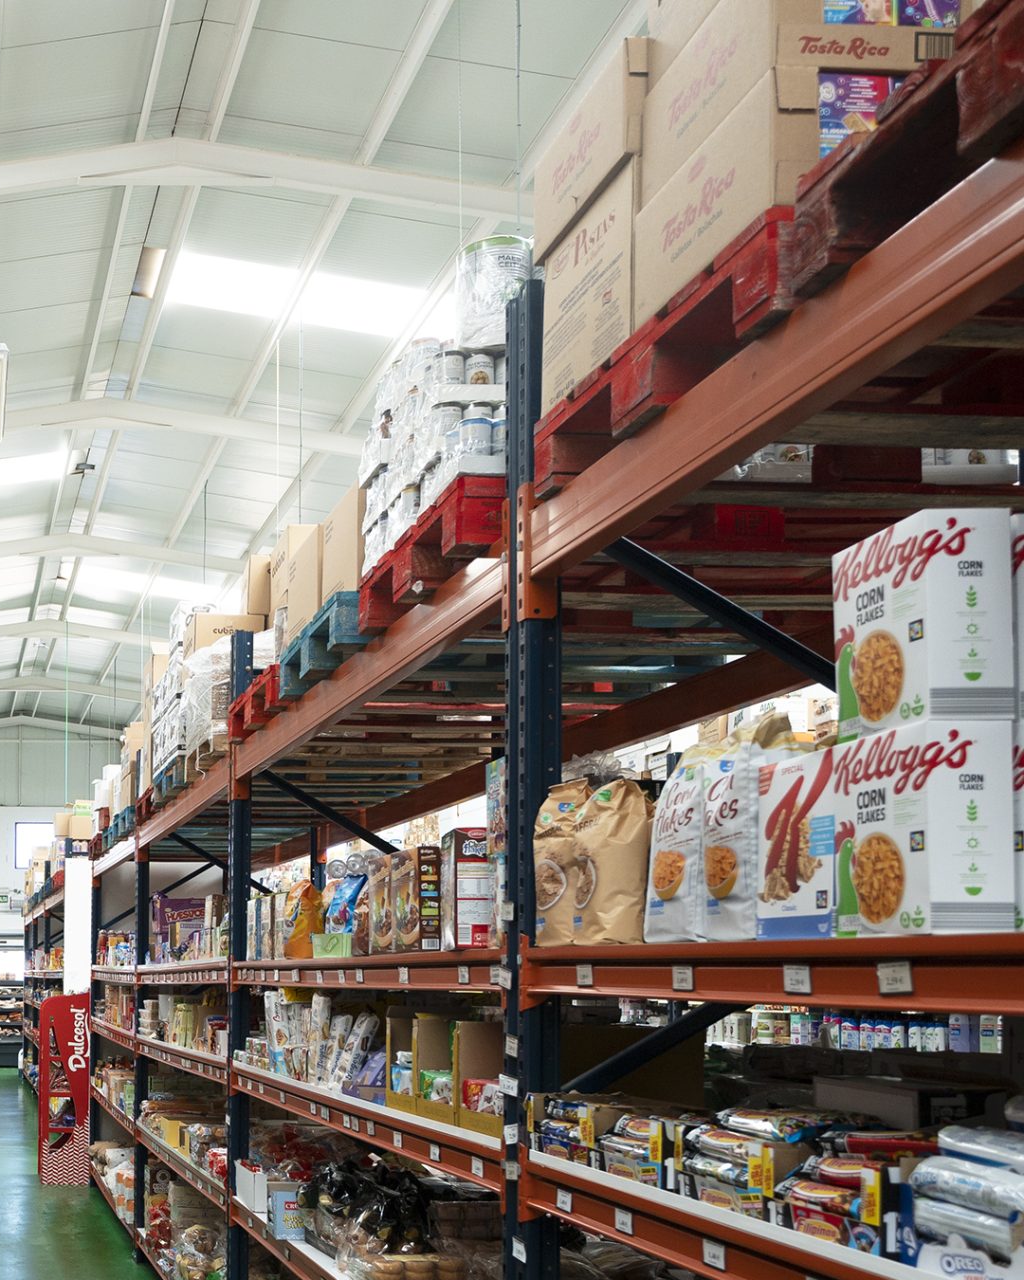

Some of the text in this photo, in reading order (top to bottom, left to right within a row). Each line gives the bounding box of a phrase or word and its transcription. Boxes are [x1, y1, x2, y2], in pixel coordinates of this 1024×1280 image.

[799, 36, 890, 59] Tosta Rica
[662, 167, 736, 252] Tosta Rica
[833, 517, 971, 602] Kellogg's
[957, 560, 983, 570] CORN
[958, 569, 983, 577] FLAKES
[856, 584, 885, 612] CORN
[856, 605, 885, 627] FLAKES
[781, 764, 804, 776] SPECIAL
[834, 729, 973, 796] Kellogg's
[959, 774, 984, 783] CORN
[959, 783, 984, 791] FLAKES
[857, 788, 886, 810] CORN
[857, 807, 886, 825] FLAKES
[68, 1004, 86, 1072] Dulcesol
[796, 1216, 840, 1238] Filipinos
[940, 1254, 985, 1275] OREO
